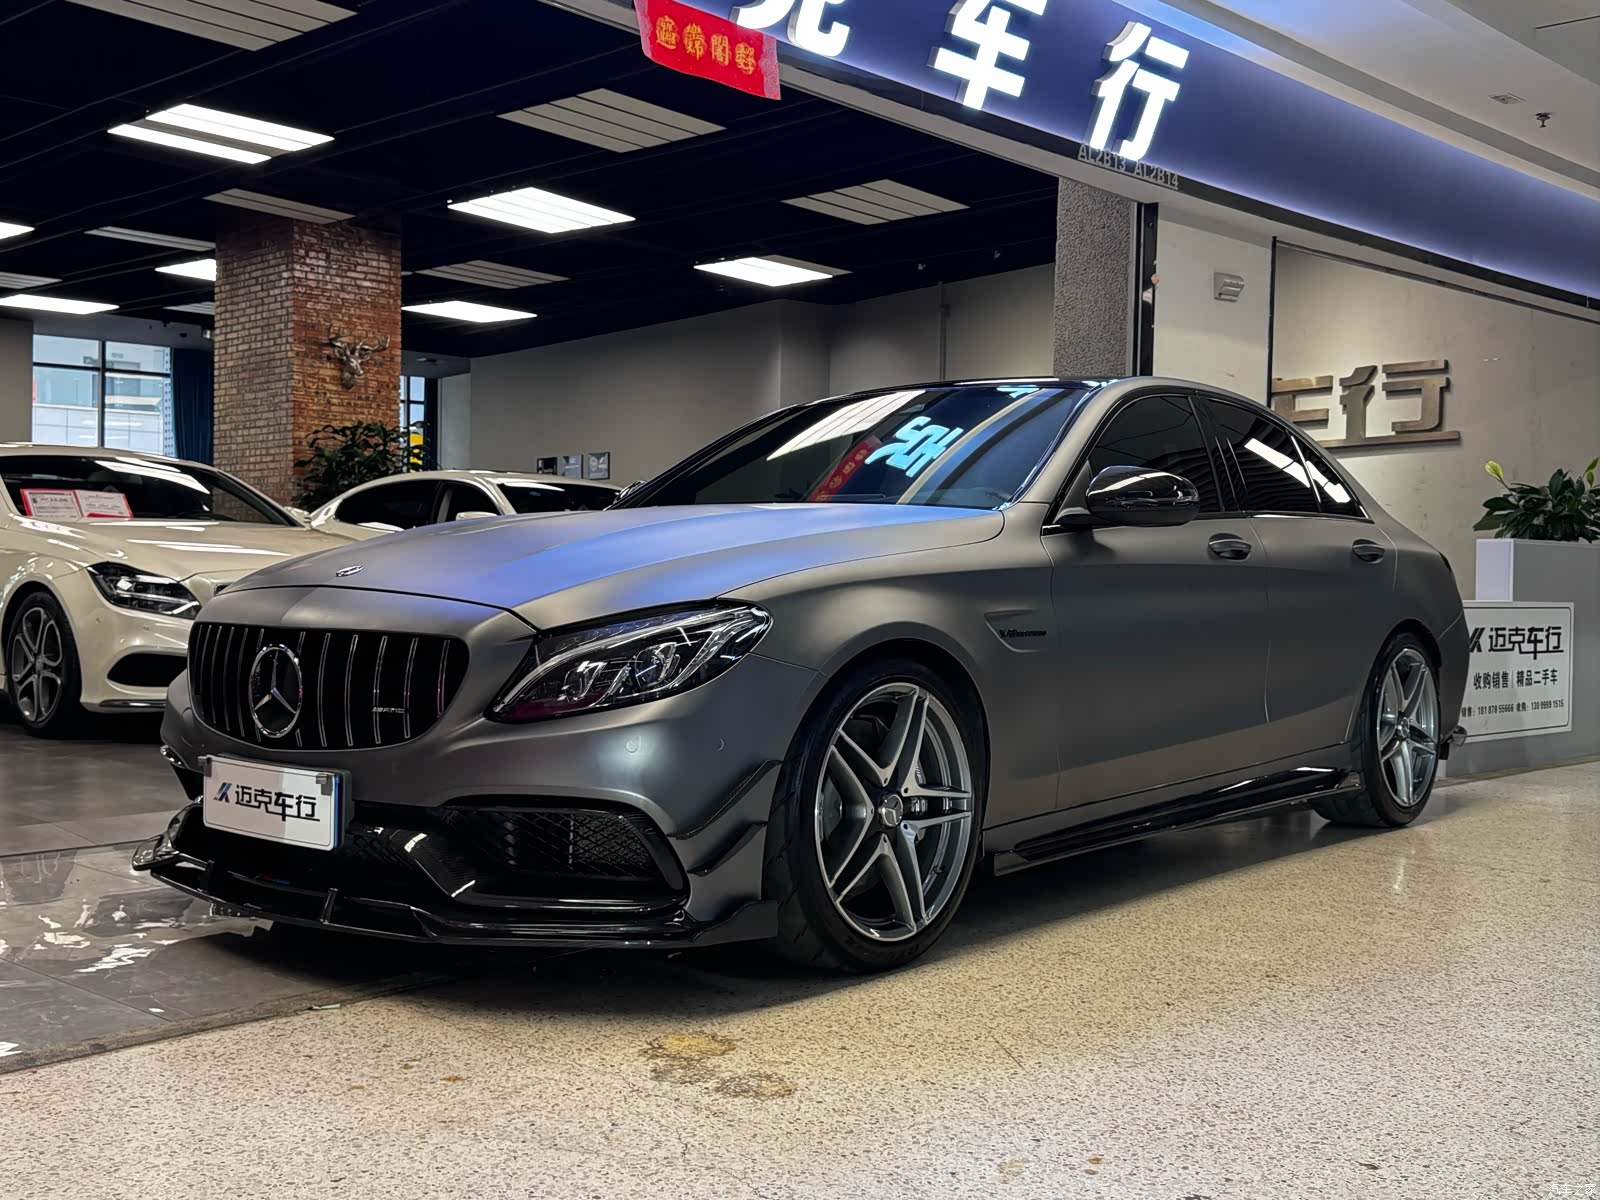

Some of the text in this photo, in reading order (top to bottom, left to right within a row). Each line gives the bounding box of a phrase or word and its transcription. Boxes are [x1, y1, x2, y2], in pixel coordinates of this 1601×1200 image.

[1077, 143, 1179, 191] AL2B13 AL2B14
[1488, 625, 1564, 660] 迈克车行
[1516, 667, 1558, 688] 精品二手车
[235, 784, 320, 821] 迈克车行
